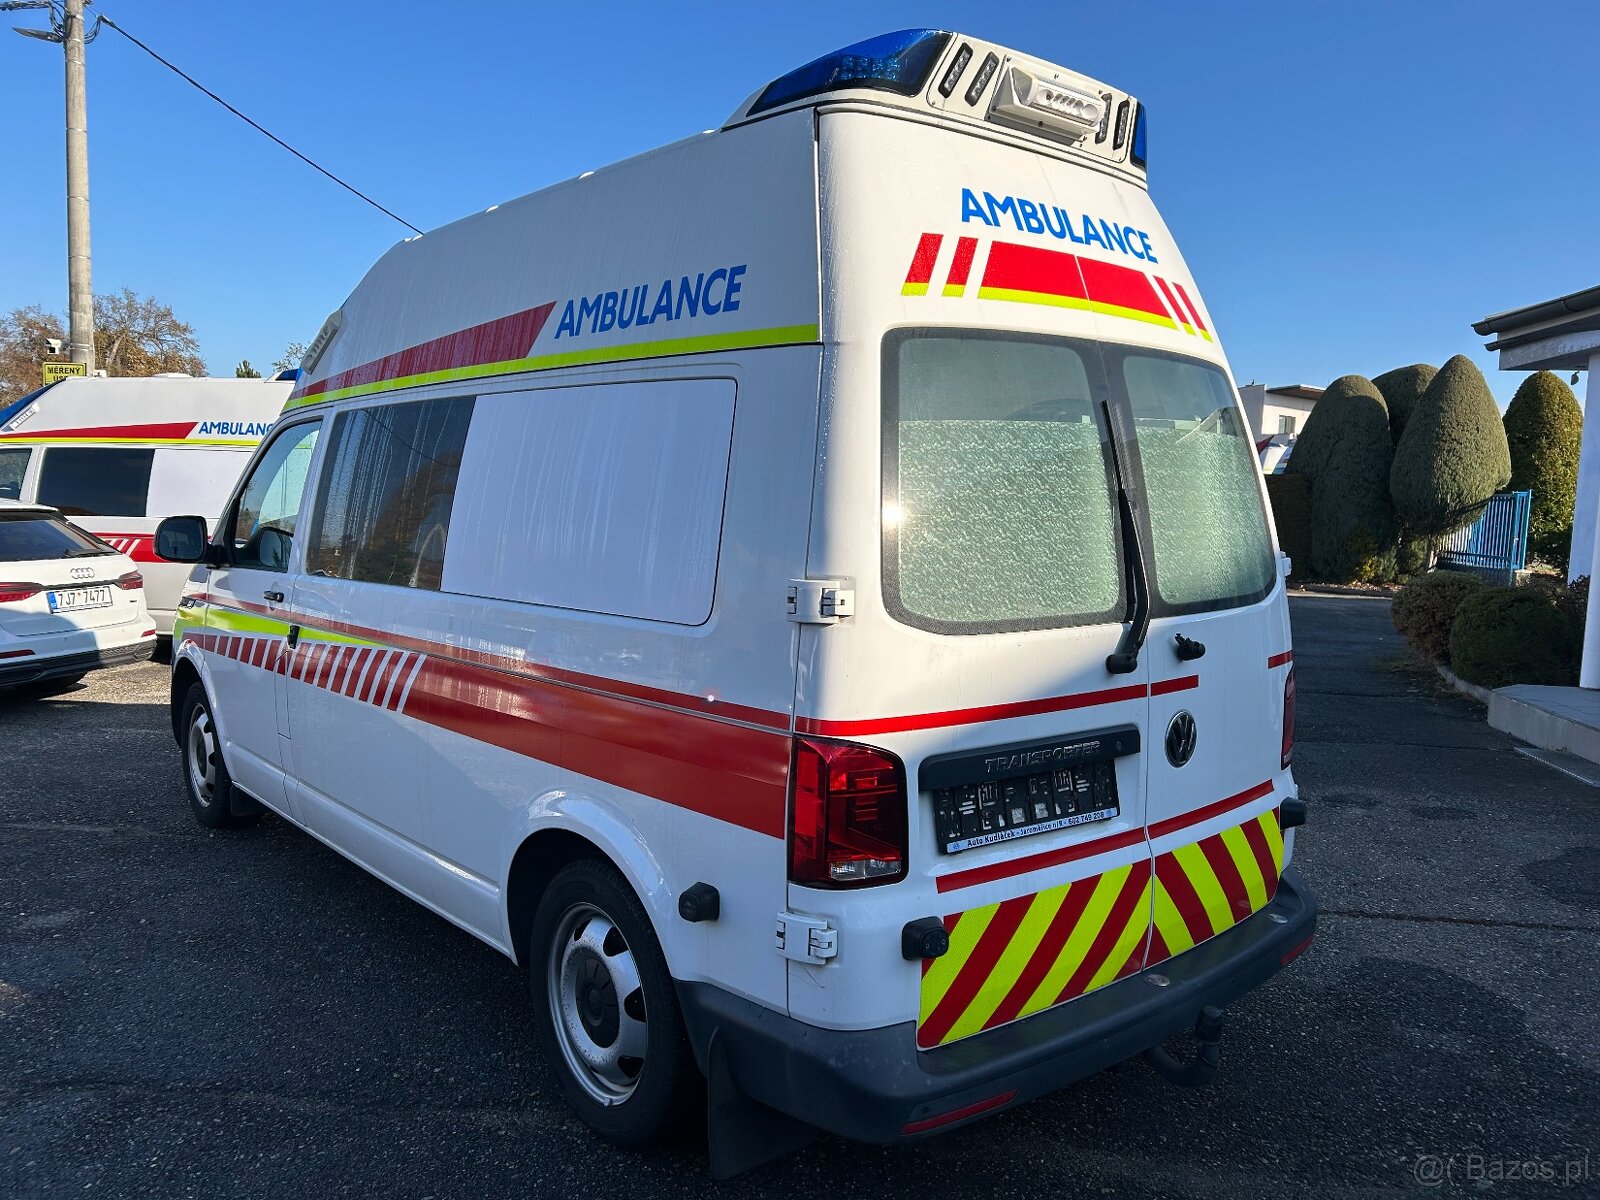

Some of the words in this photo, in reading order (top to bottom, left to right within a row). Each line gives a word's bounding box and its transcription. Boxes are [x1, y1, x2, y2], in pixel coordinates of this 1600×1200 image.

[962, 188, 1158, 264] AMBULANCE
[554, 264, 747, 339] AMBULANCE
[985, 740, 1100, 773] TRANSPORTER
[967, 838, 983, 847] Auto
[1081, 813, 1092, 822] 749
